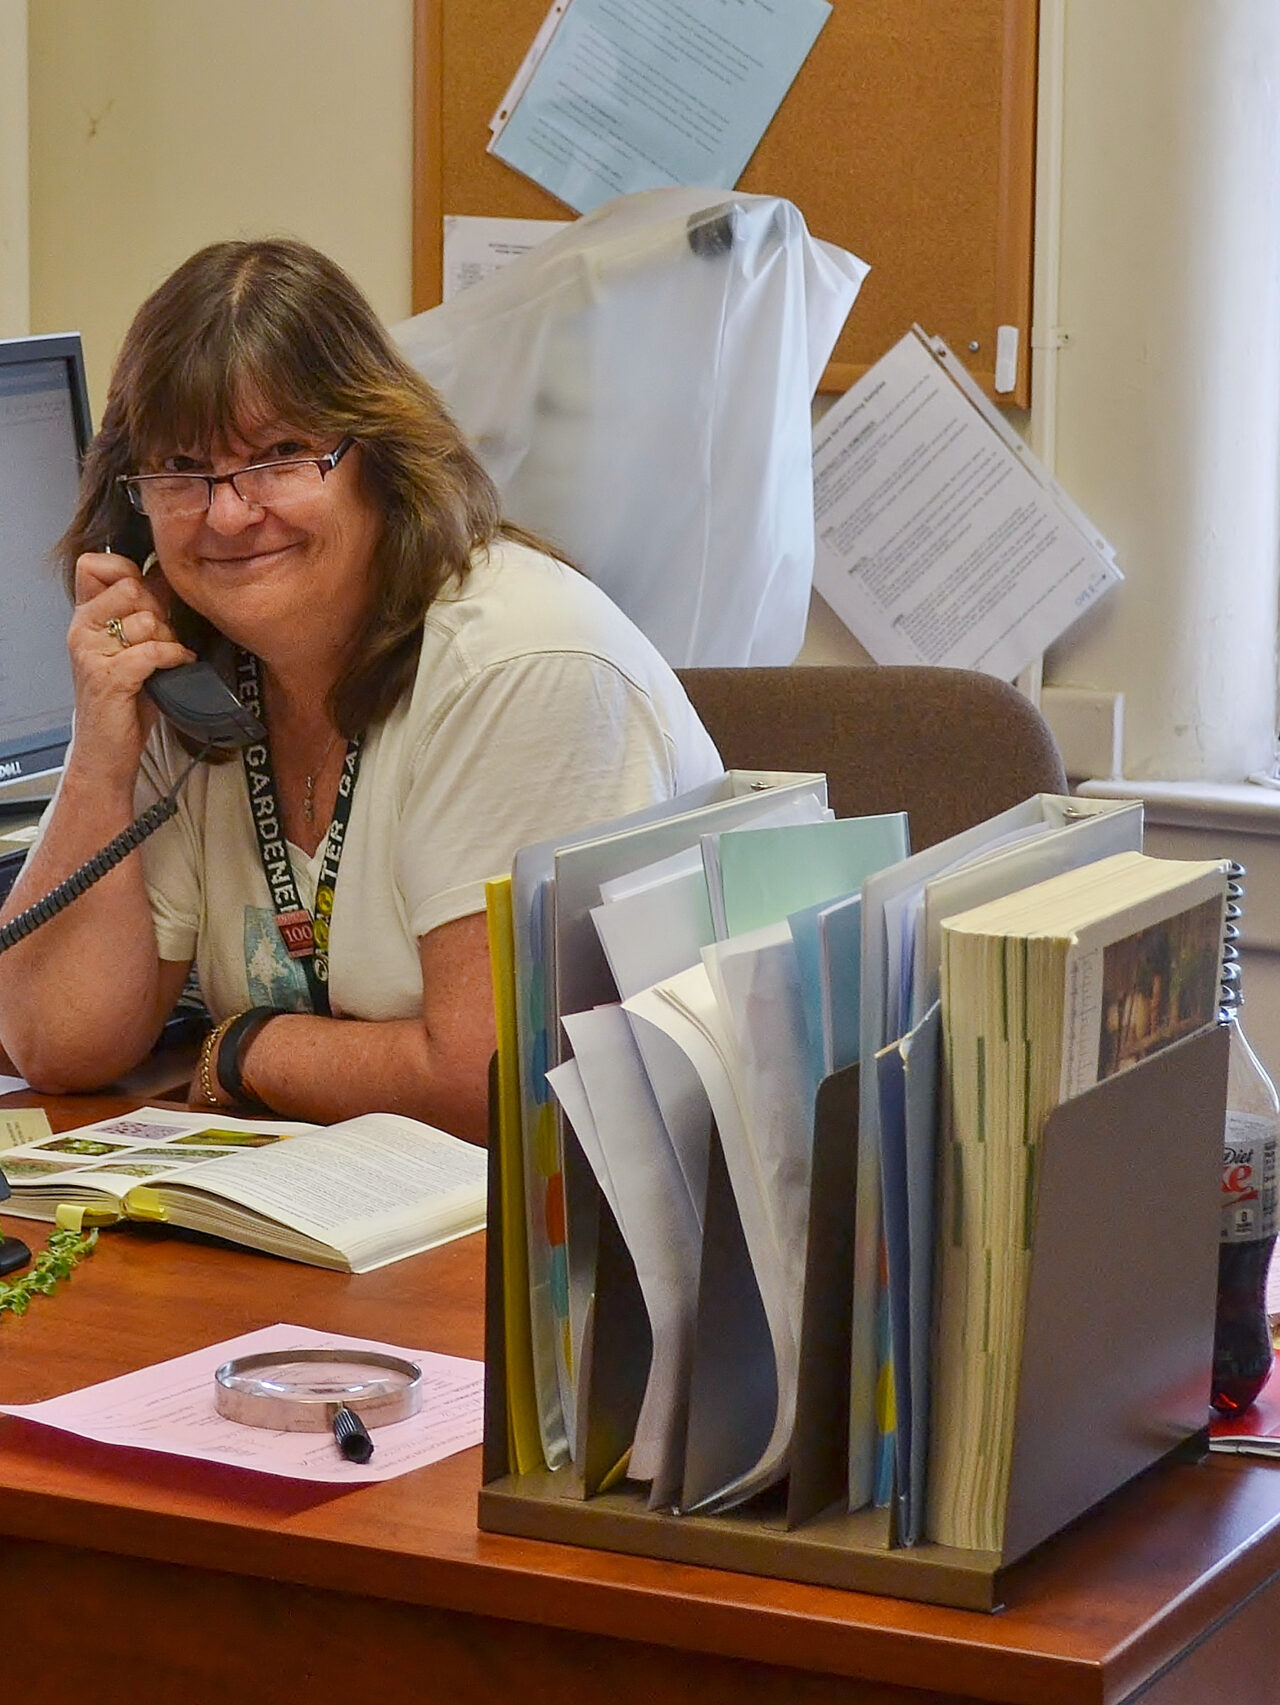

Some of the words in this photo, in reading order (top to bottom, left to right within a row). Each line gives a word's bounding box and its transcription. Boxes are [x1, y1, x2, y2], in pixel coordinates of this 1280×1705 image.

[320, 819, 344, 882] TER
[286, 925, 312, 942] 100
[1224, 1147, 1254, 1165] Diet
